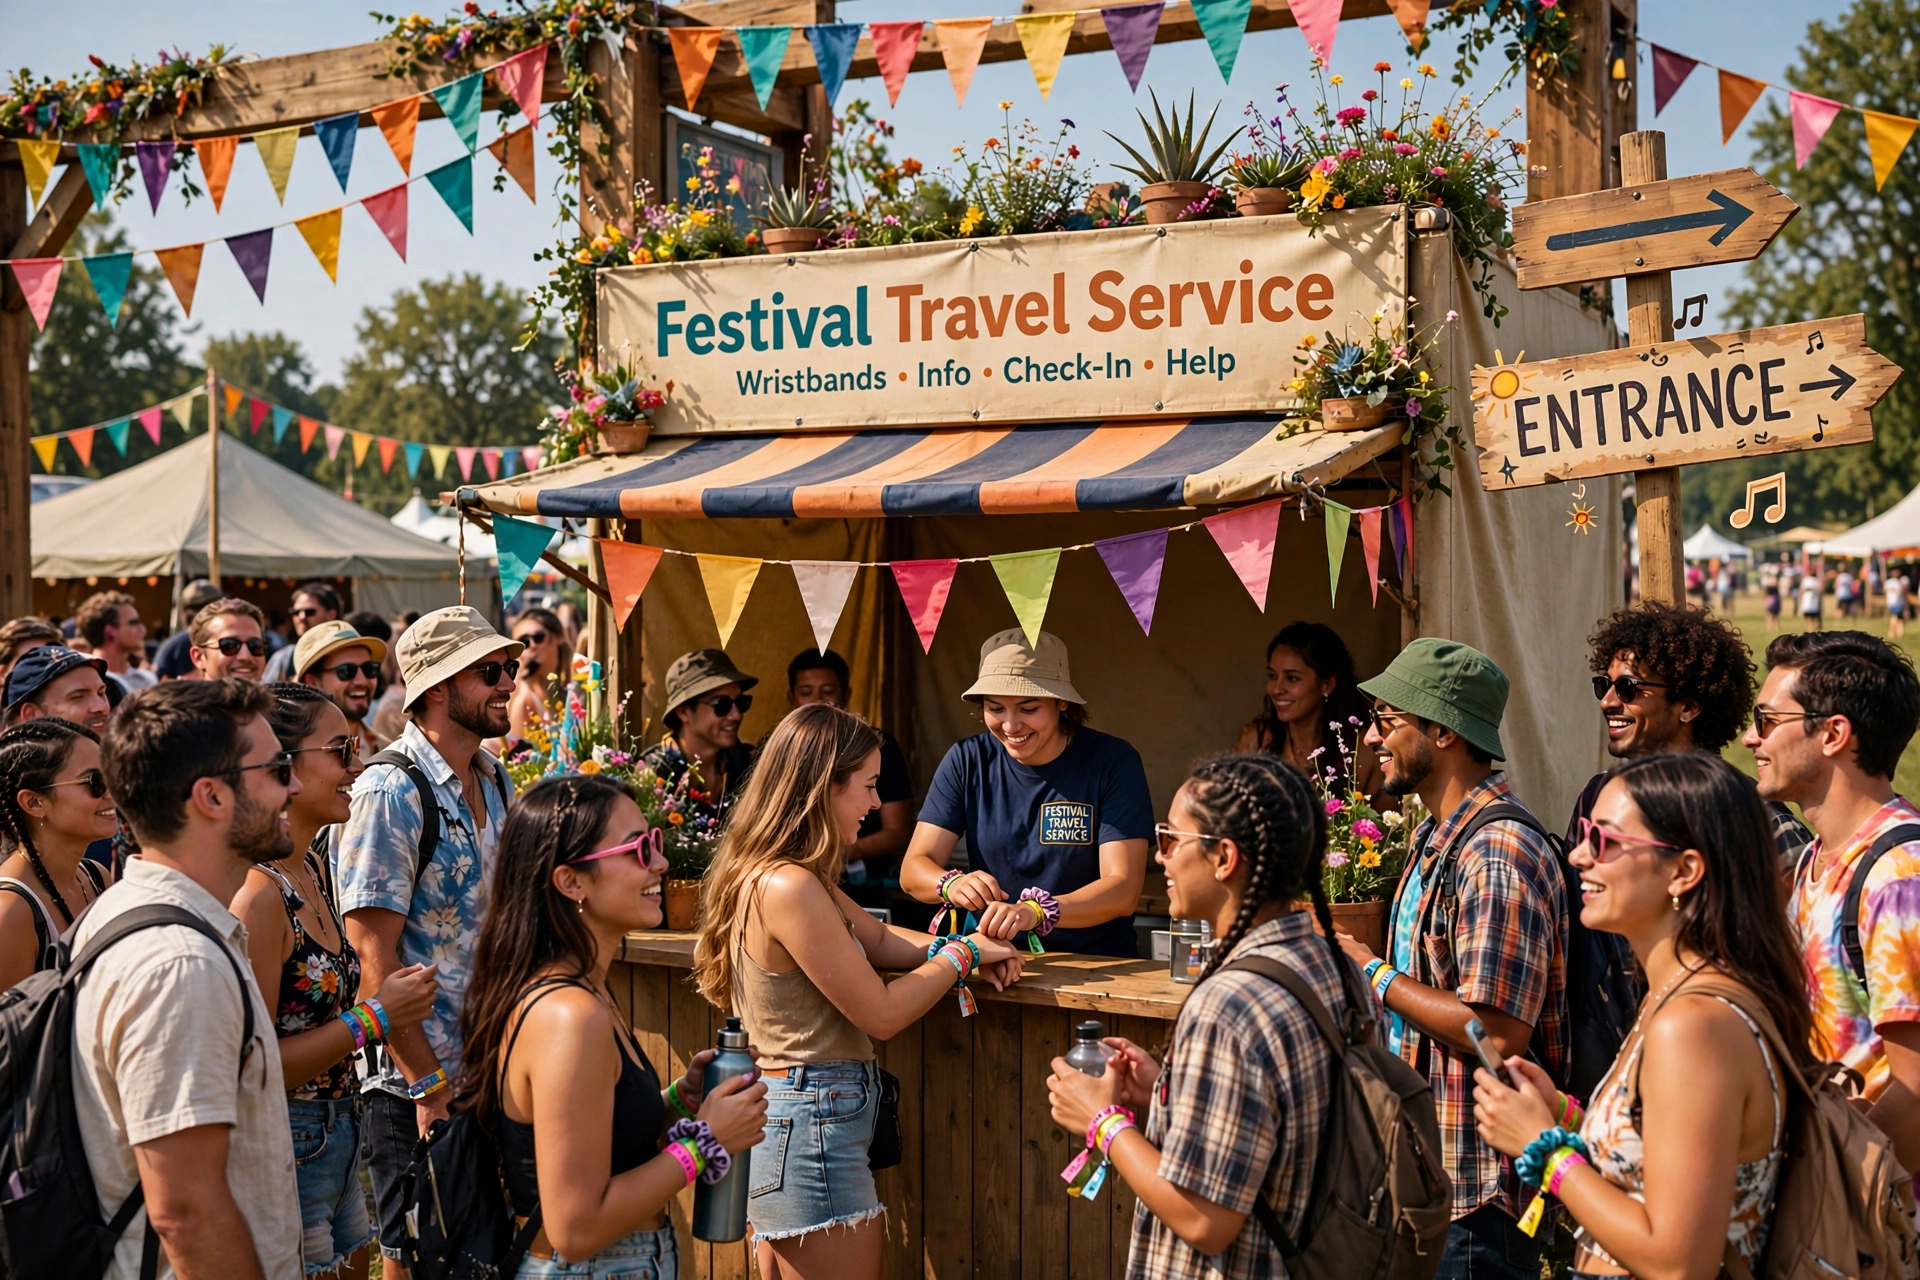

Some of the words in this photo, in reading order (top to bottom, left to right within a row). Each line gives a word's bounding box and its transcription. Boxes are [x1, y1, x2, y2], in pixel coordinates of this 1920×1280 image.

[657, 285, 873, 358] Festival
[885, 271, 1071, 343] Travel
[1087, 258, 1335, 333] Service
[736, 363, 887, 396] Wristbands
[918, 358, 971, 388] Info
[1003, 352, 1132, 384] Check-In
[1167, 346, 1236, 382] Help
[1514, 357, 1791, 458] ENTRANCE
[1045, 805, 1089, 817] FESTIVAL
[1048, 817, 1087, 829] TRAVEL
[1045, 829, 1088, 841] SERVICE
